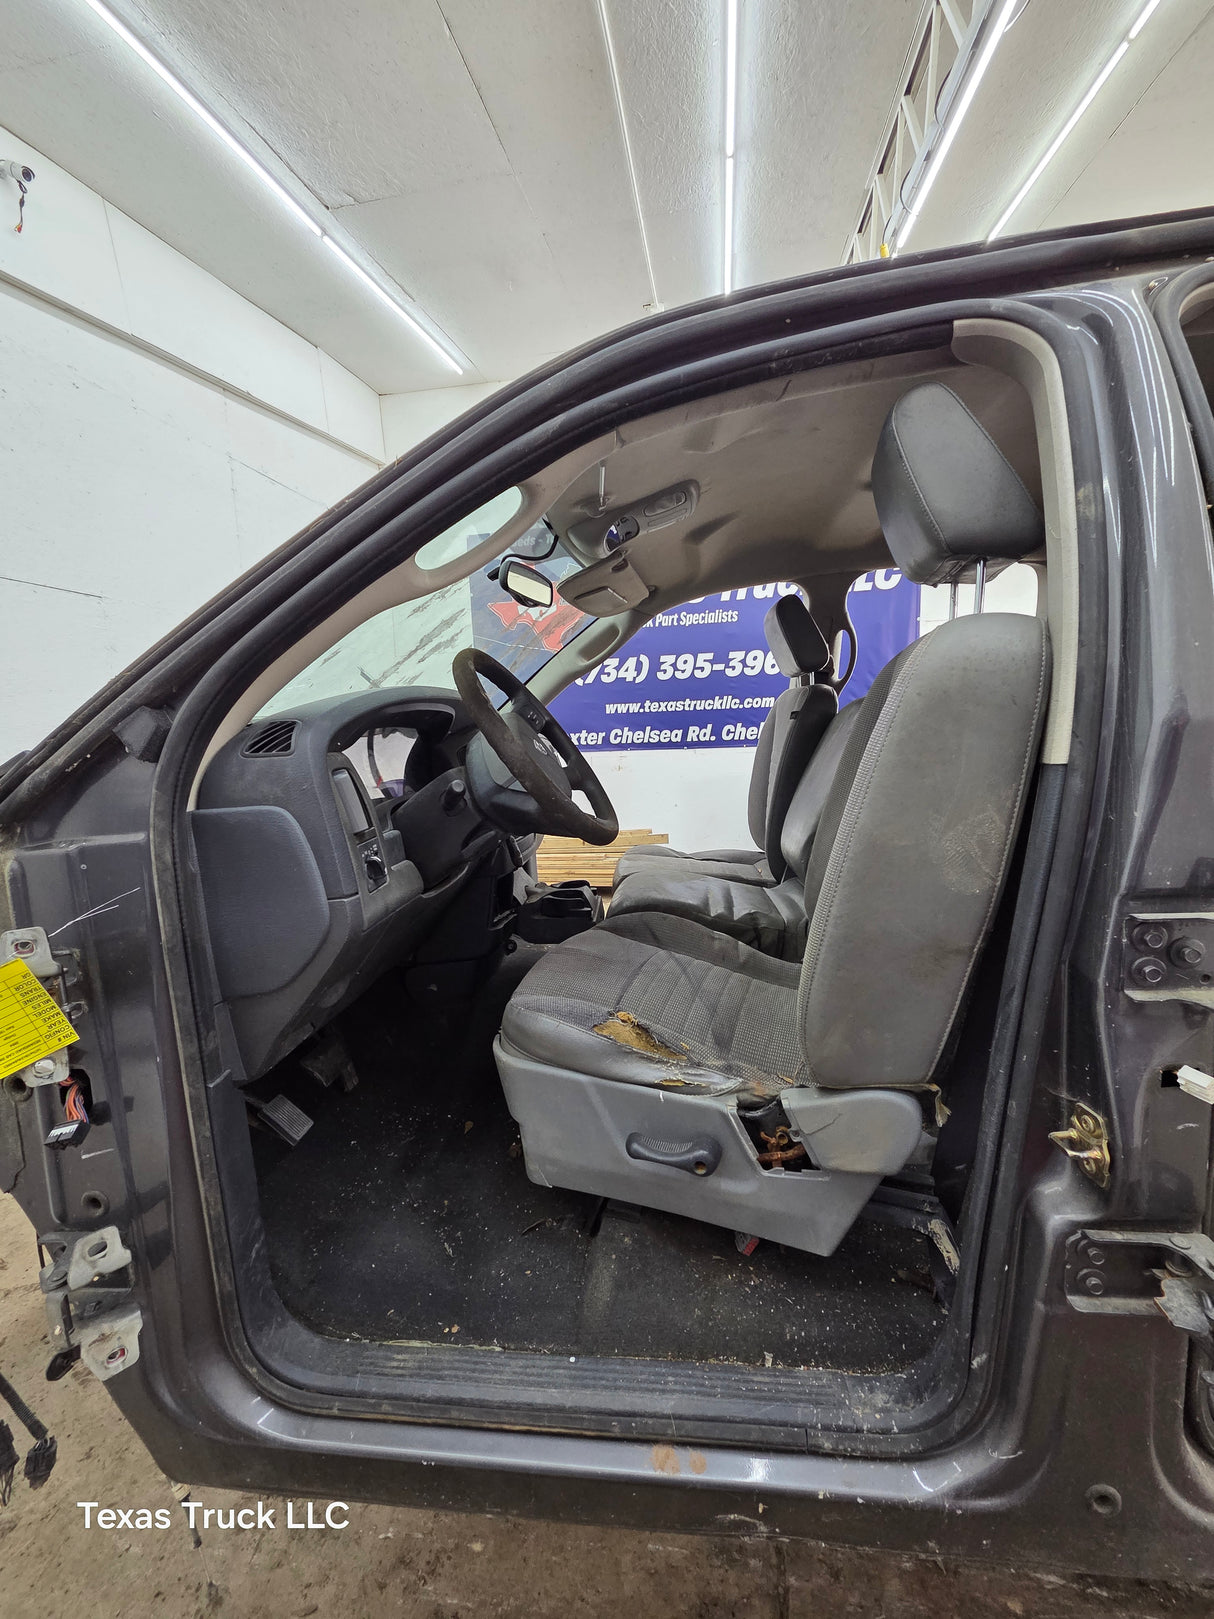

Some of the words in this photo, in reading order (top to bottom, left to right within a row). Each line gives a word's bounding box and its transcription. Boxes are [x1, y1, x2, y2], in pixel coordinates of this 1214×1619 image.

[720, 581, 803, 602] ruc
[848, 567, 902, 592] LC
[655, 613, 679, 628] Part
[679, 610, 739, 627] Specialists
[574, 653, 650, 687] 734)
[605, 695, 775, 715] www.texastruckllc.com
[609, 726, 684, 745] Chelsea
[686, 723, 716, 742] Rd.
[14, 979, 36, 992] COLOR
[19, 985, 42, 998] TRANS
[22, 992, 47, 1006] ENGINE
[31, 998, 52, 1010] MILES
[33, 1005, 57, 1018] MODEL
[41, 1011, 61, 1023] MAKE
[47, 1018, 66, 1030] YEAR
[44, 1024, 70, 1039] CONFIG
[62, 1031, 75, 1039] VIN
